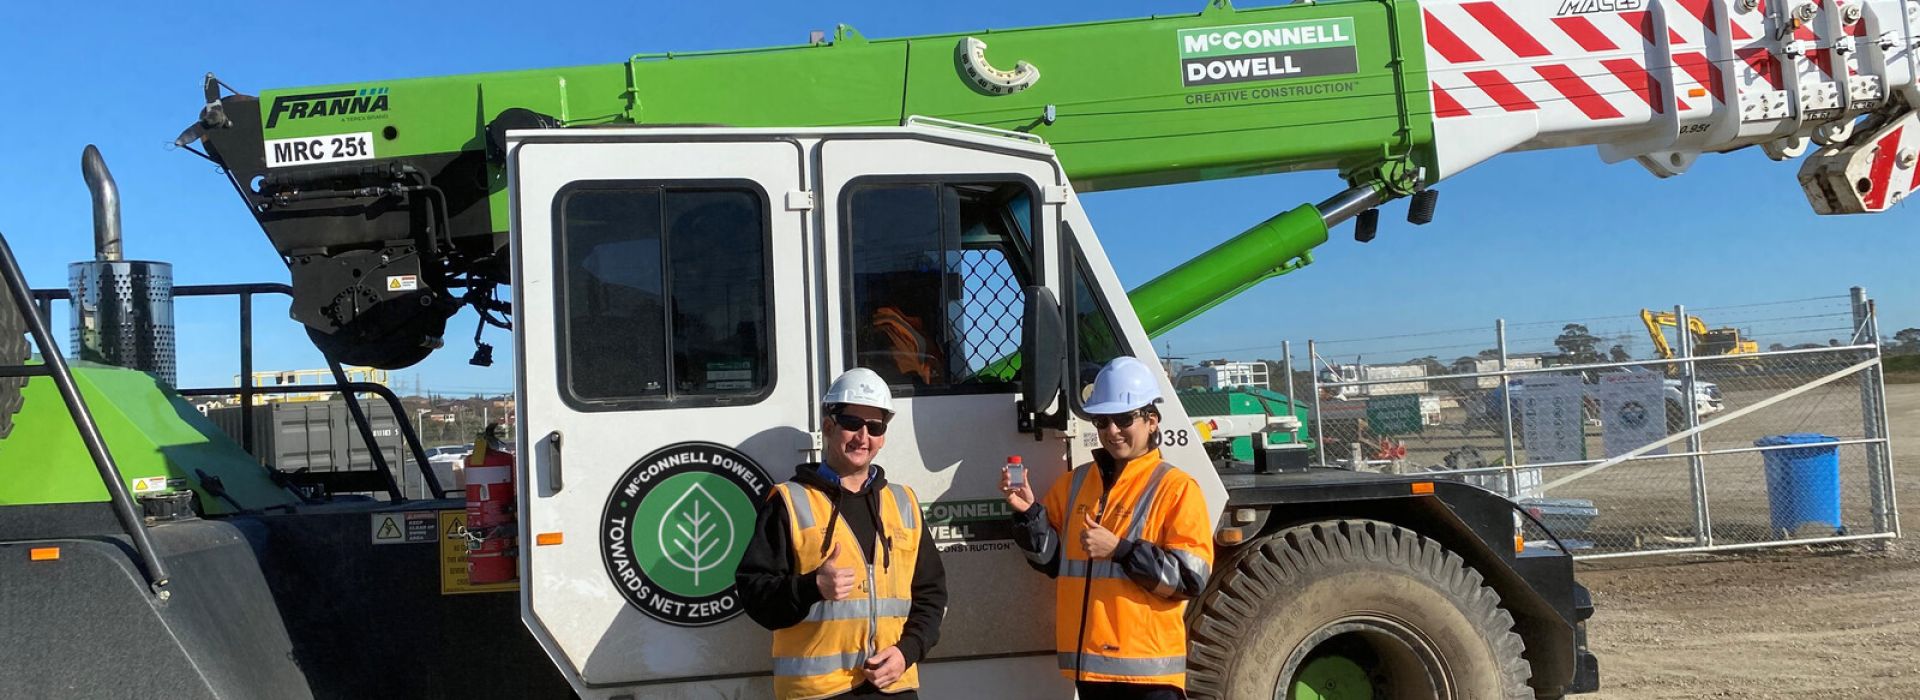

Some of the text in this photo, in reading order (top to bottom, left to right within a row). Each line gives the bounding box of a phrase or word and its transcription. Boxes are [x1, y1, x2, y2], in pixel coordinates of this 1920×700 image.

[1187, 56, 1301, 81] DOWELL
[265, 90, 389, 128] FRANNA
[1185, 90, 1248, 105] CREATIVE
[274, 136, 367, 163] MRC 25t
[712, 454, 765, 496] DOWELL
[921, 502, 1013, 519] CONNELL
[928, 524, 975, 540] WELL
[610, 517, 734, 617] TOWARDS NET ZERO
